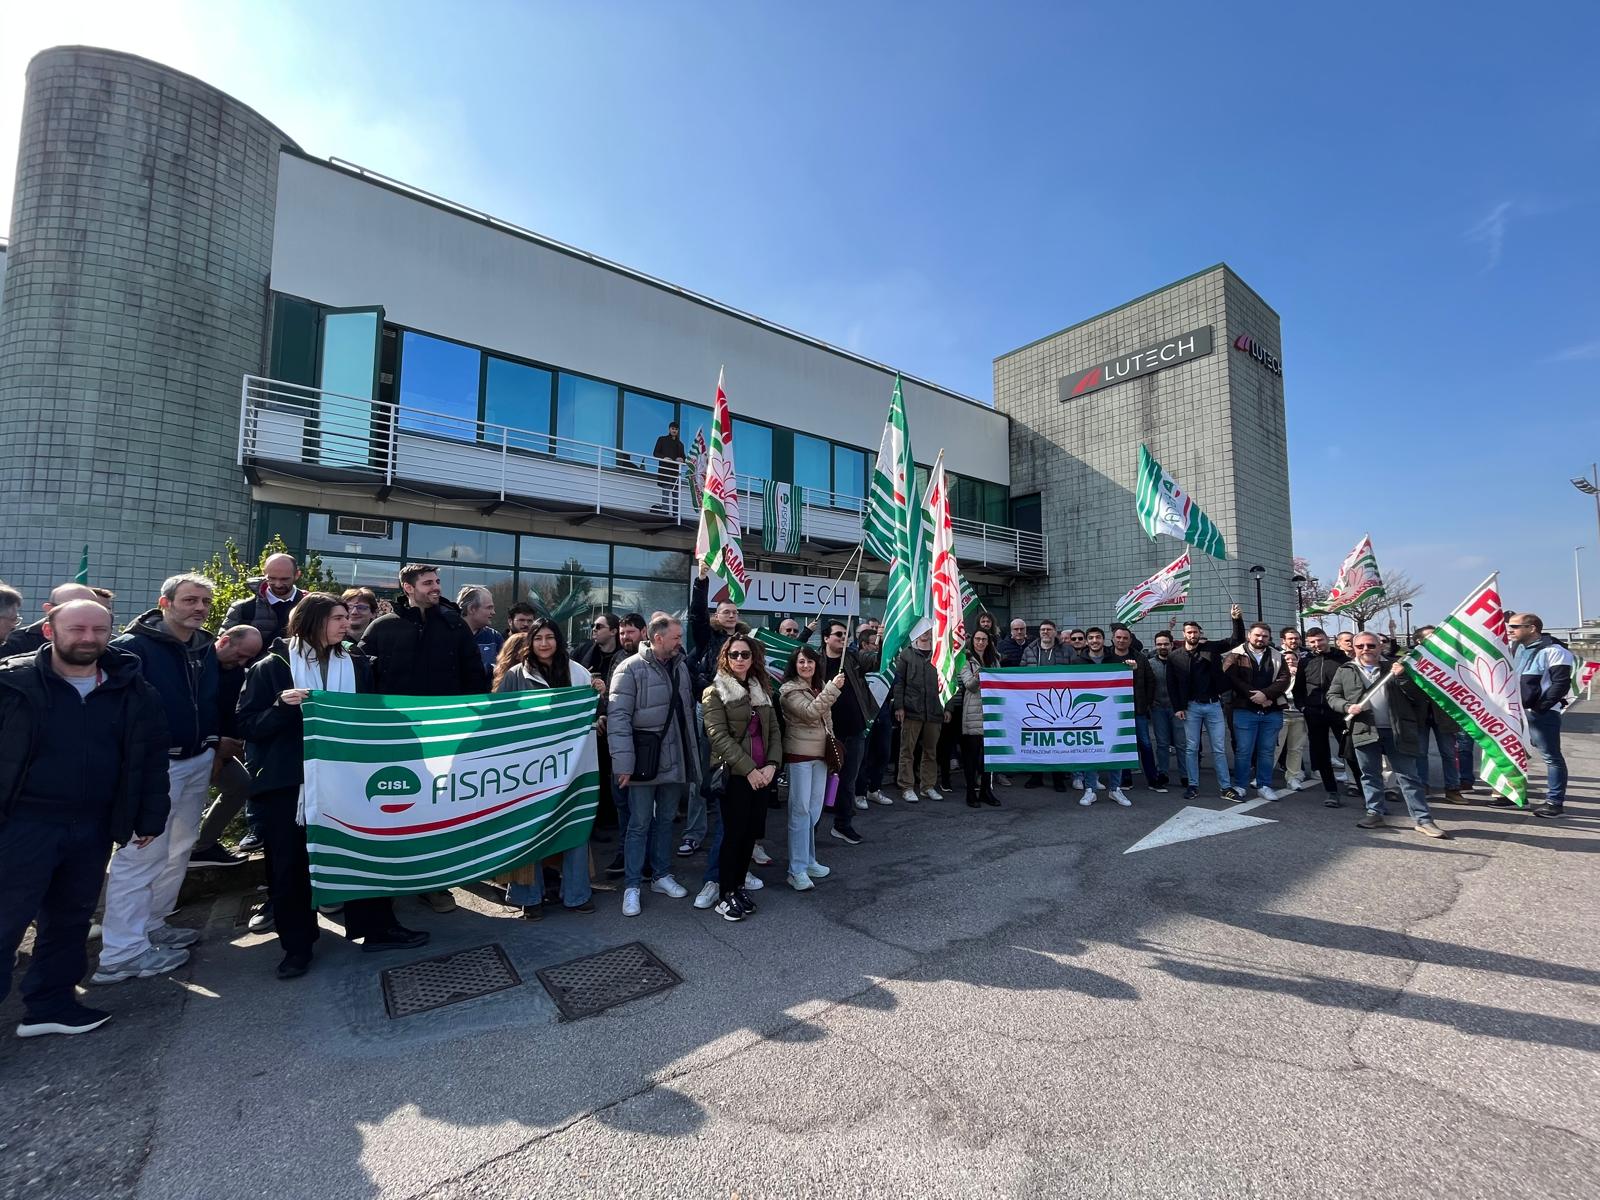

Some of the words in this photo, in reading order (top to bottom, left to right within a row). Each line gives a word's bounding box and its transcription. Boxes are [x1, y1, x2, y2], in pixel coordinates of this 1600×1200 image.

[1105, 336, 1195, 381] LUTECH
[758, 579, 847, 606] LUTECH
[1021, 730, 1104, 747] FIM-CISL
[377, 780, 411, 790] CISL
[432, 747, 574, 805] FISASCAT
